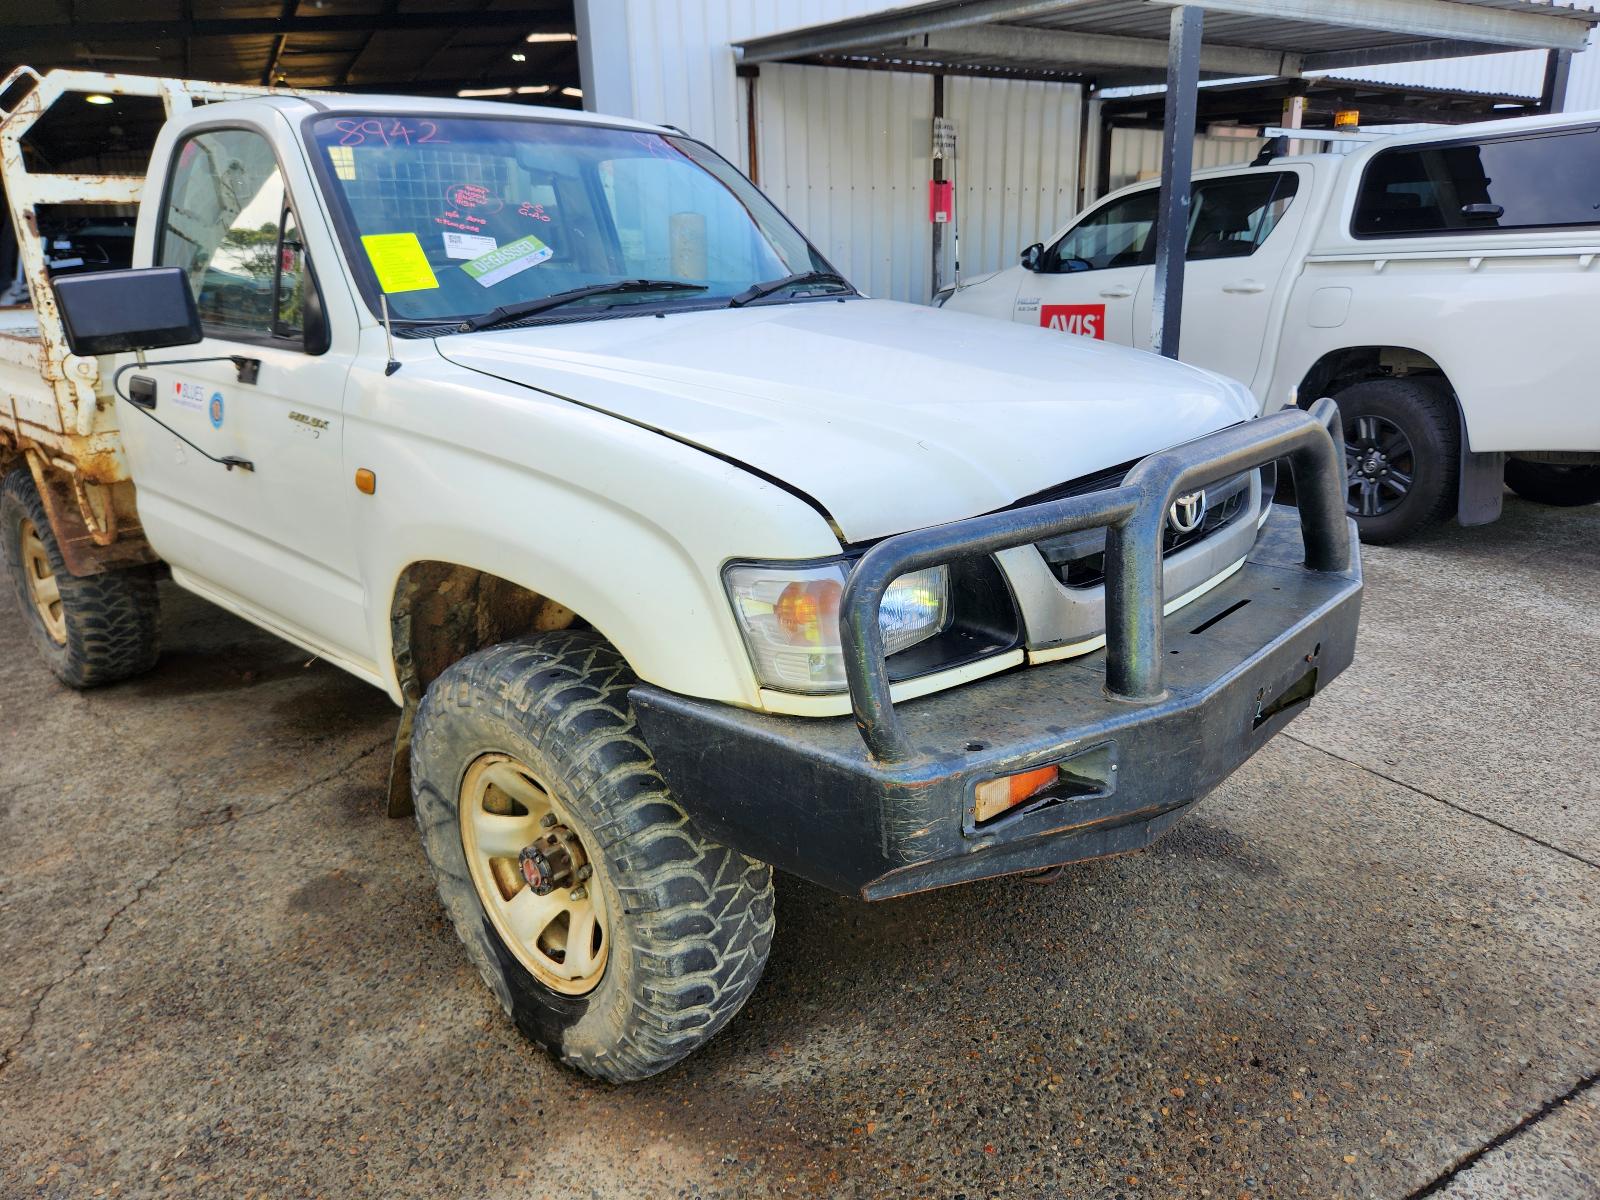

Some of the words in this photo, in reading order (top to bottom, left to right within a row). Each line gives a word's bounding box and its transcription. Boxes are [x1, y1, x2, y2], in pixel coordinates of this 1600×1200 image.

[335, 119, 451, 146] 8942
[471, 240, 537, 273] DEGASSED
[1048, 313, 1096, 338] AVIS
[183, 383, 204, 402] BLUES
